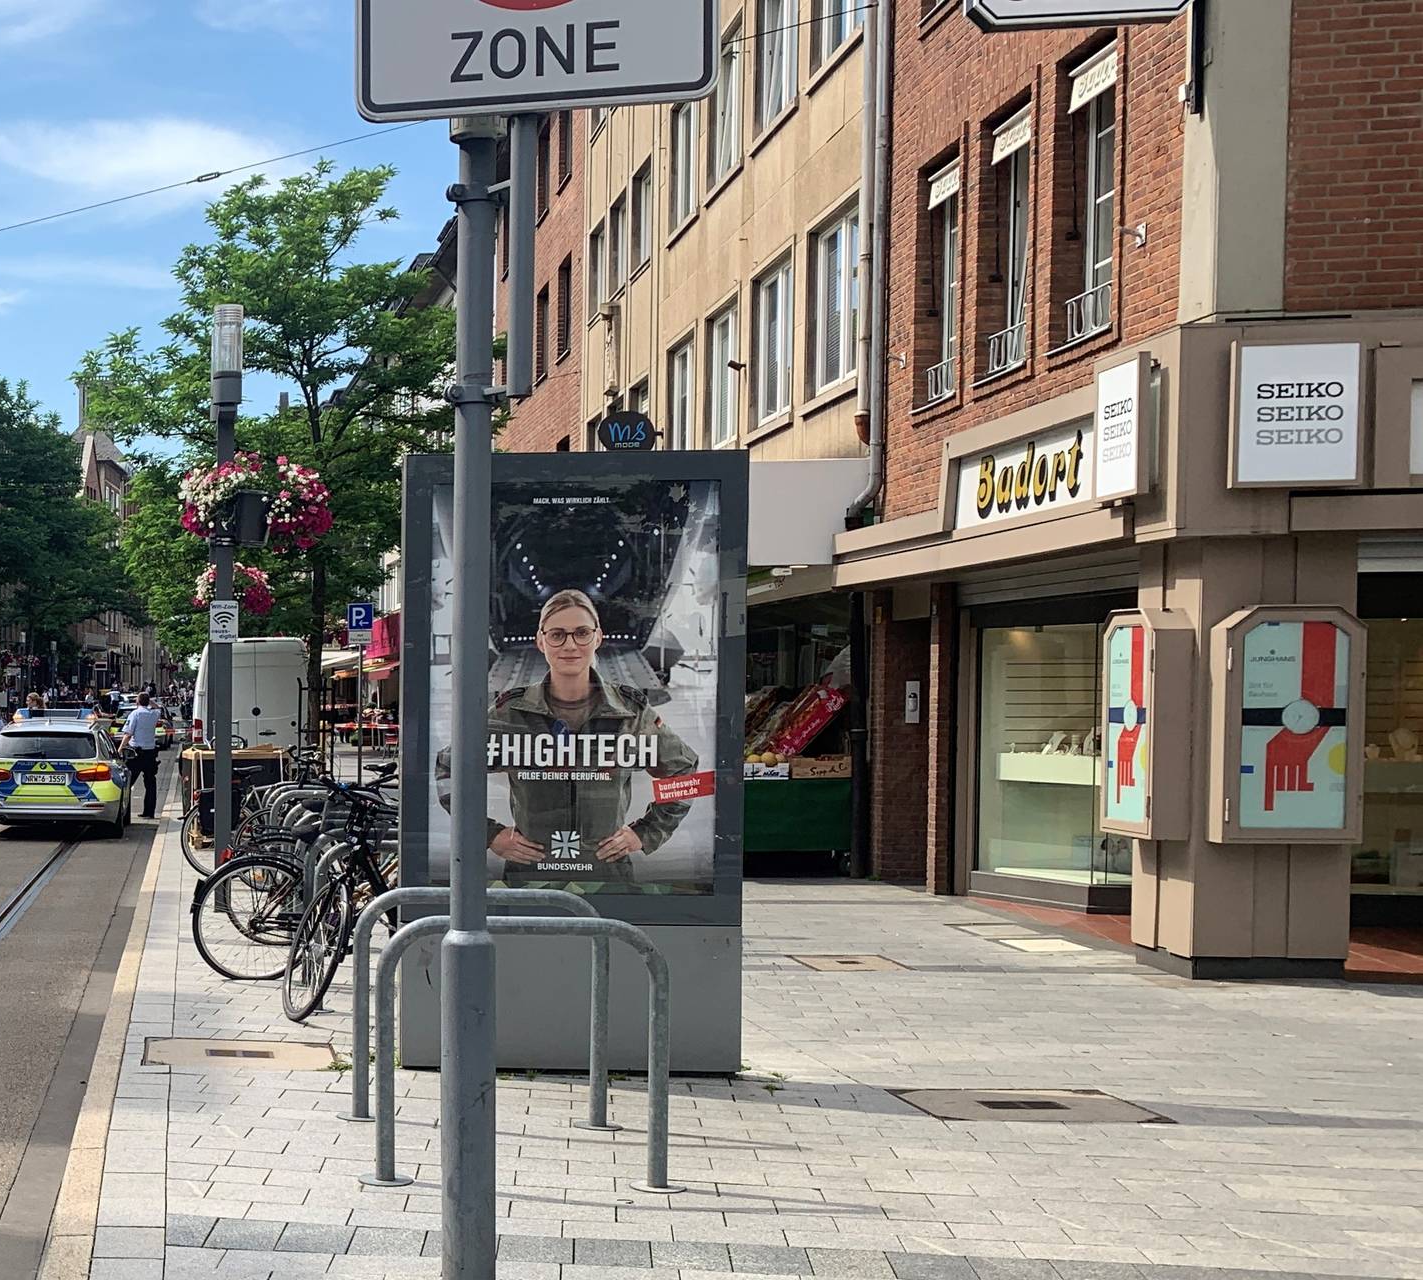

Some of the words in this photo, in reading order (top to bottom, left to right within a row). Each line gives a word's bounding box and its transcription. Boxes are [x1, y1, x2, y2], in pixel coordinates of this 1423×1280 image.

[450, 20, 620, 83] ZONE
[1257, 381, 1344, 399] SEIKO
[1104, 397, 1133, 420] SEIKO
[1256, 404, 1344, 423] SEIKO
[1104, 419, 1133, 442] SEIKO
[1256, 427, 1343, 446] SEIKO
[1102, 441, 1132, 463] SEIKO
[977, 429, 1083, 520] Badort
[532, 497, 551, 505] MACH,
[593, 496, 611, 504] ZÄHLT.
[352, 607, 365, 626] P
[487, 734, 658, 768] #HIGHTECH
[518, 772, 541, 781] FOLGE
[542, 772, 569, 781] DEINER
[571, 772, 612, 781] BERUFUNG.
[658, 778, 700, 791] bundeswehr
[660, 788, 698, 800] karriere.de
[537, 863, 593, 871] BUNDESWEHR
